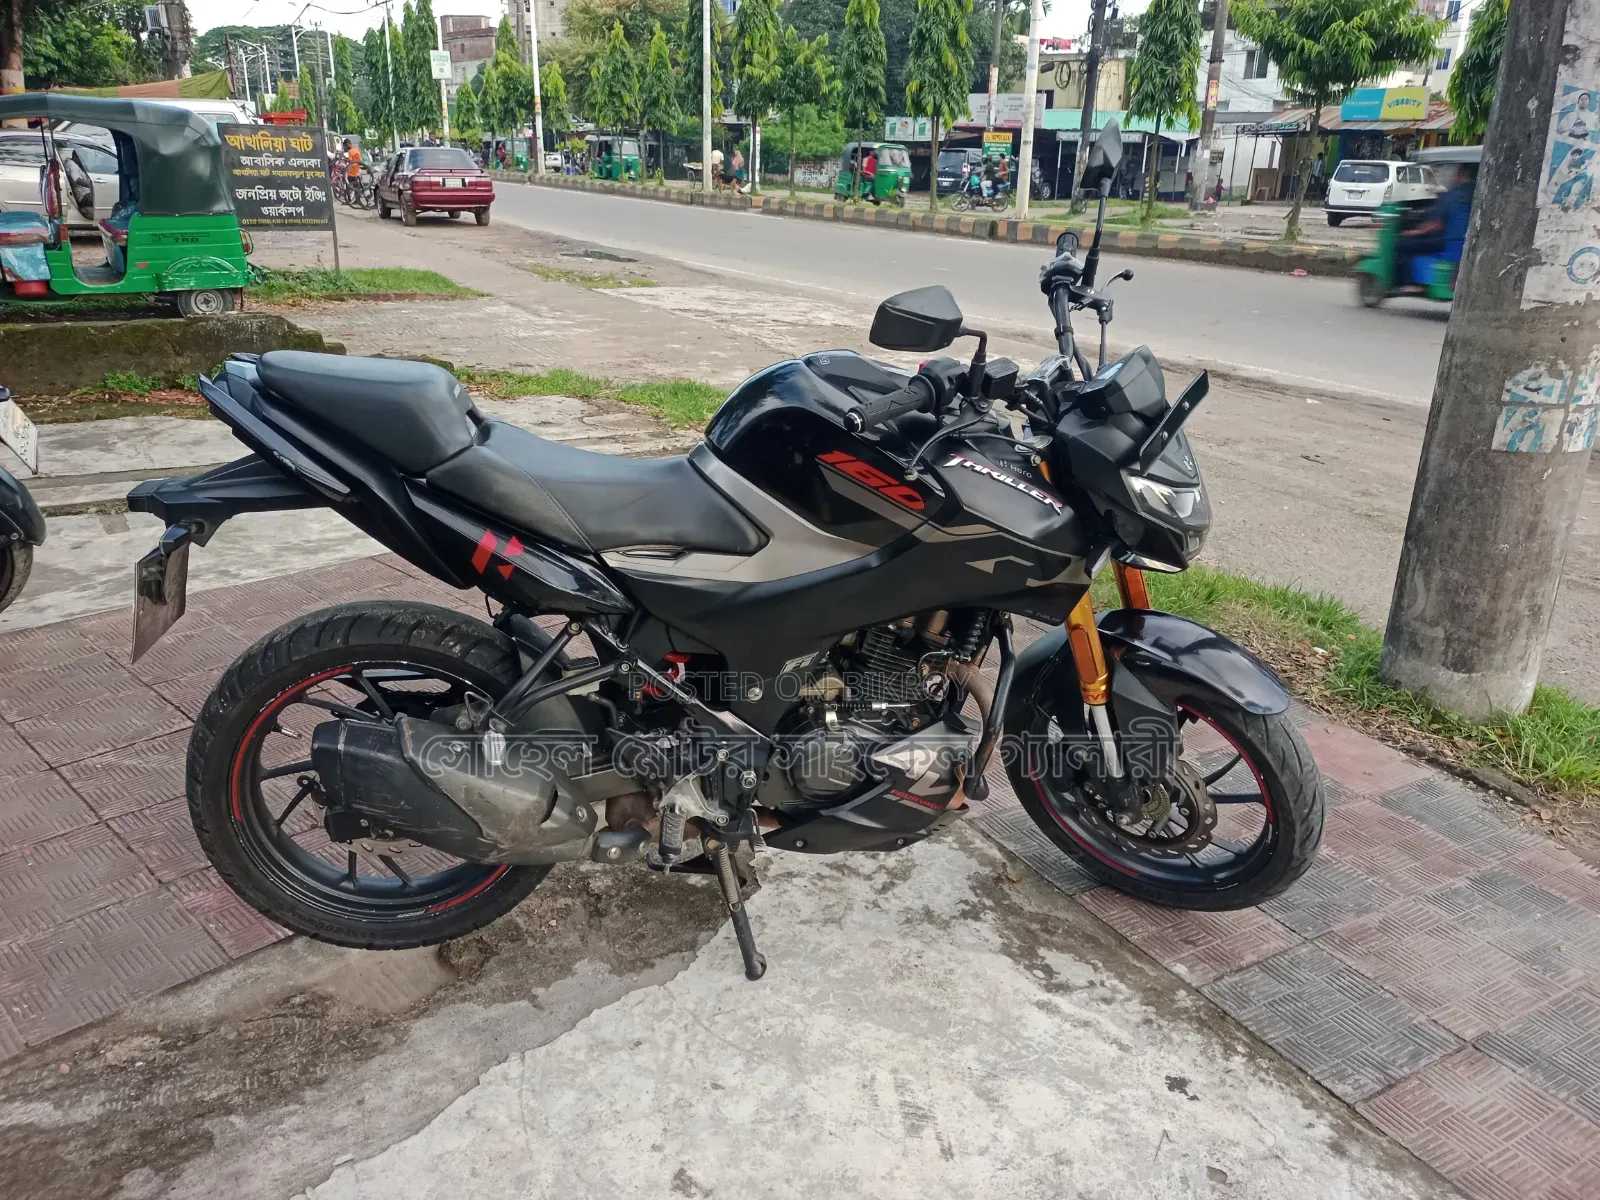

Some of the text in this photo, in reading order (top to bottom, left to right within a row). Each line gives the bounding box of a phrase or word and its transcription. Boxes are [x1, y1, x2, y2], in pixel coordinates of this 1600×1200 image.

[224, 130, 314, 152] আখালিয়া ঘাট
[240, 153, 322, 168] আবাসিক এলাকা
[235, 185, 277, 201] জনপ্রিয়
[279, 185, 302, 202] অটো
[260, 203, 305, 217] ওয়ার্কসপ
[1010, 464, 1033, 479] Hero
[942, 453, 1063, 517] THRILLER
